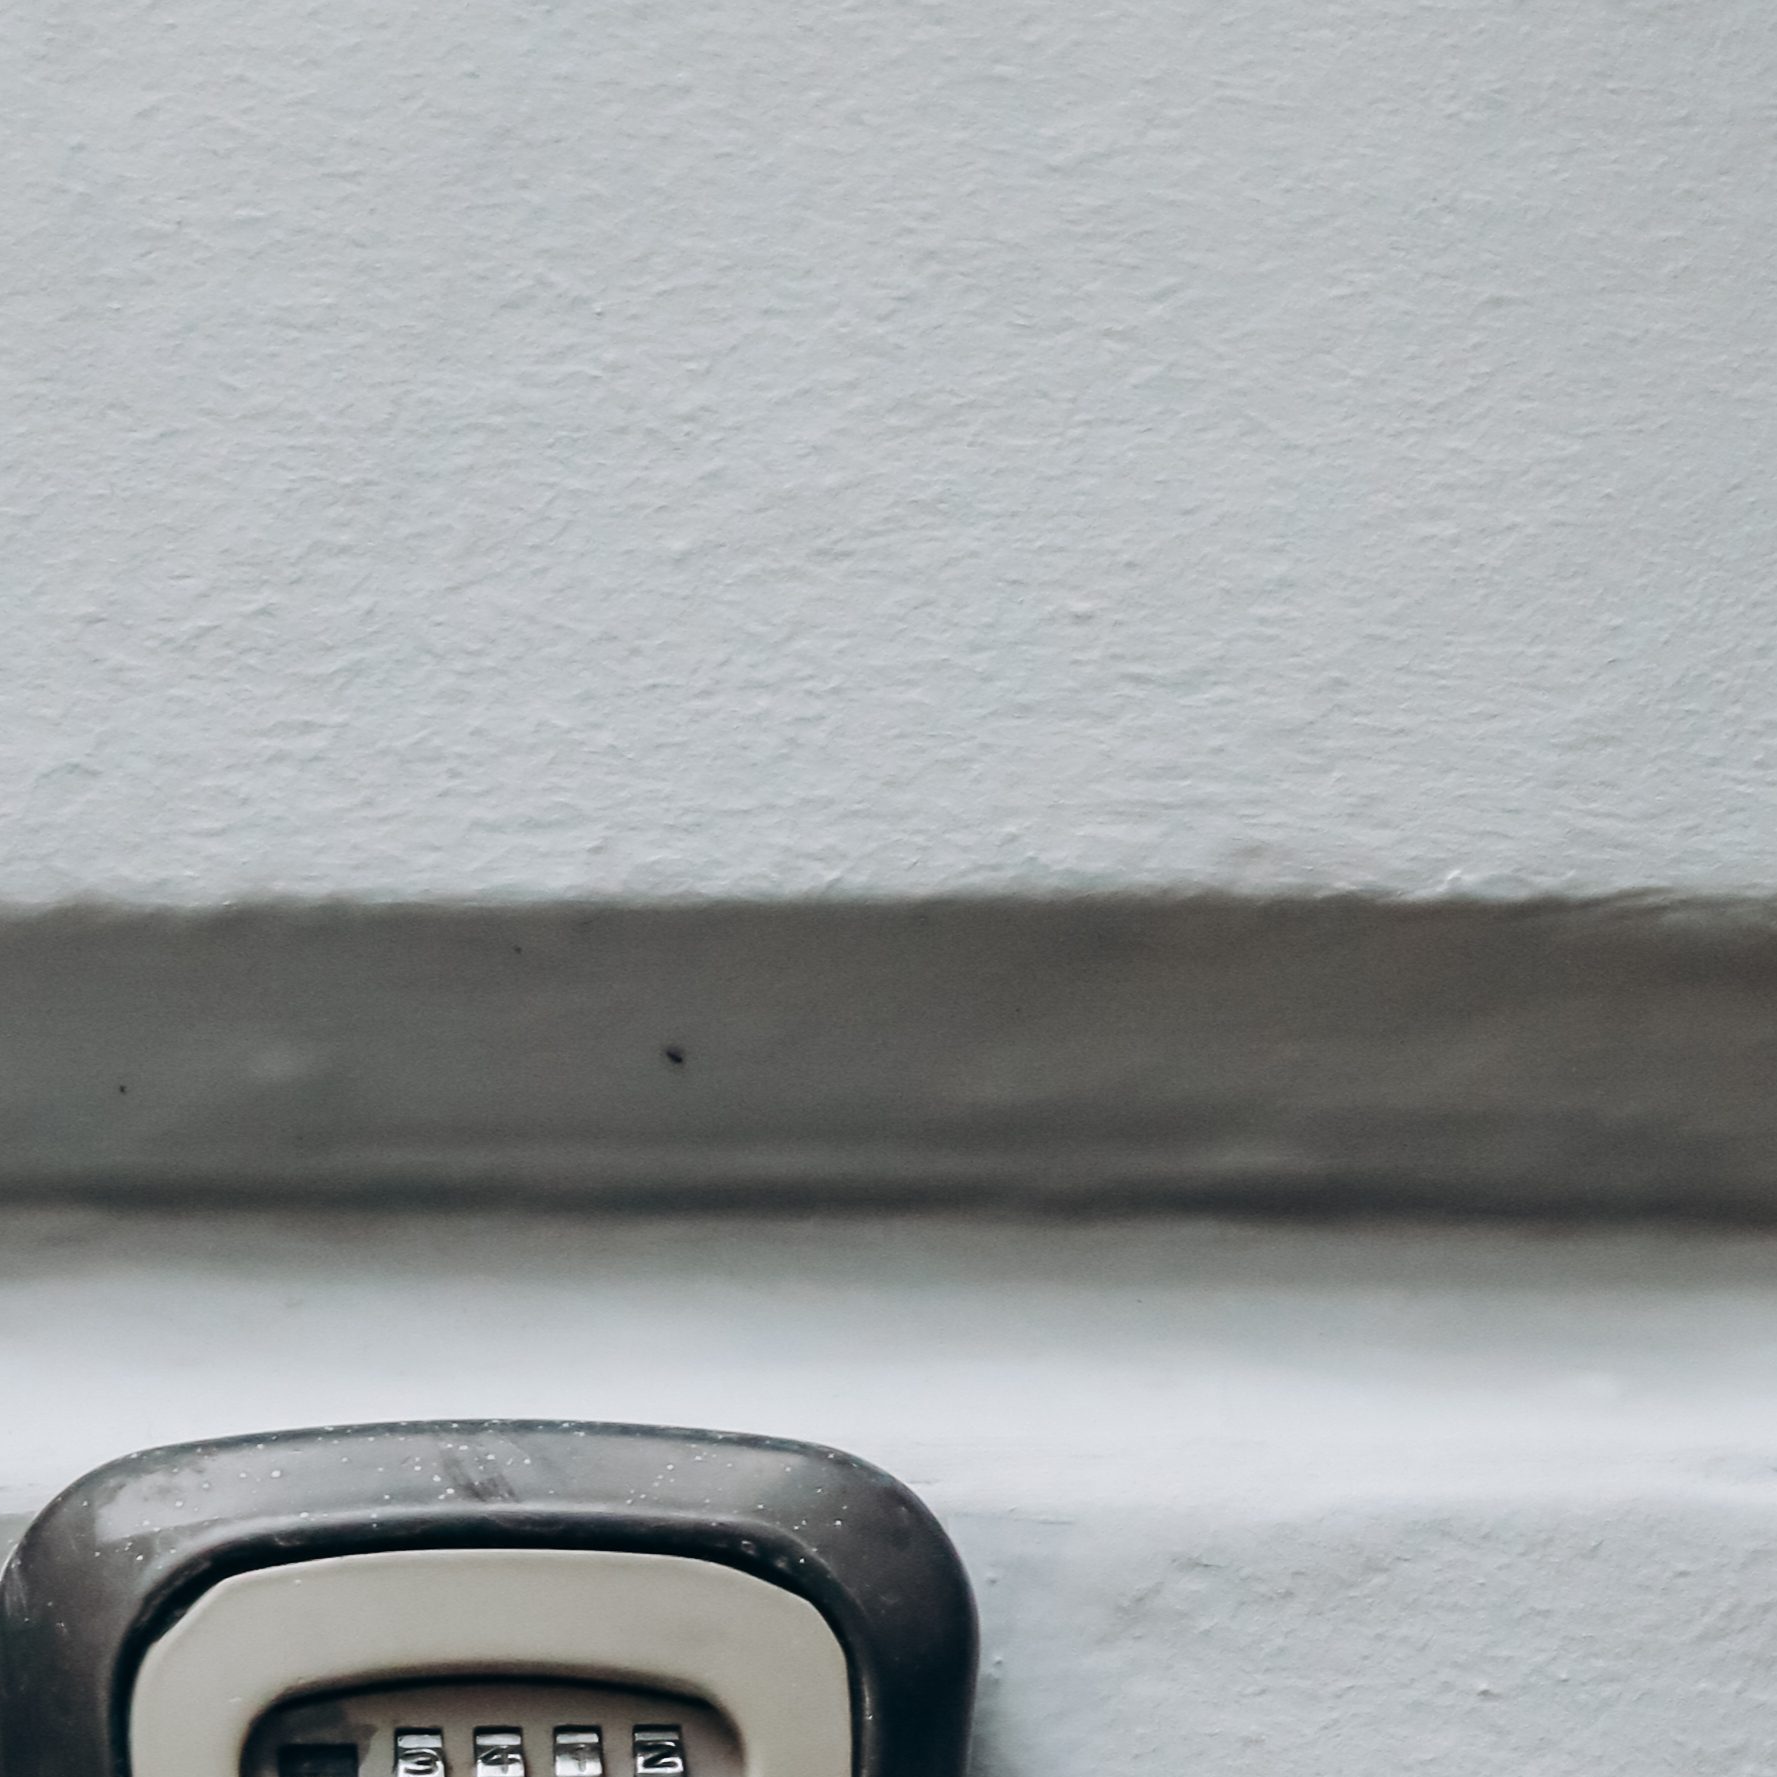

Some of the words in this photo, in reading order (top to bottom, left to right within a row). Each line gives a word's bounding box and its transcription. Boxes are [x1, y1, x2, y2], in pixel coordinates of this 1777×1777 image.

[402, 1748, 442, 1775] 3
[479, 1745, 521, 1774] 4
[640, 1741, 679, 1769] 2
